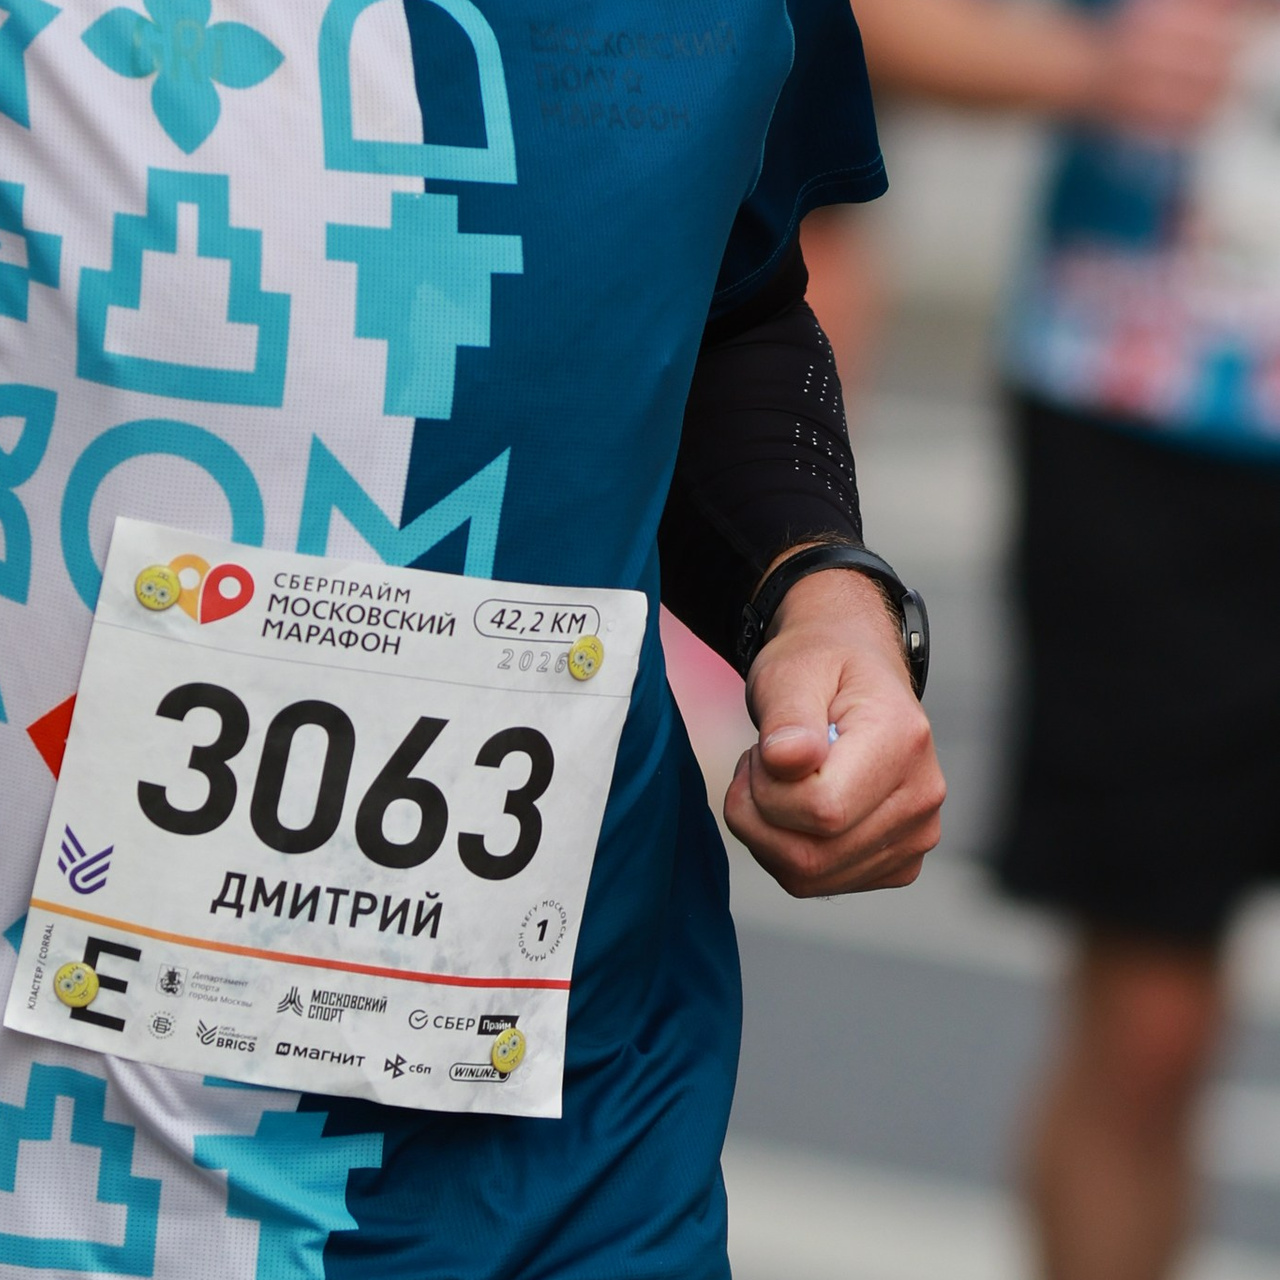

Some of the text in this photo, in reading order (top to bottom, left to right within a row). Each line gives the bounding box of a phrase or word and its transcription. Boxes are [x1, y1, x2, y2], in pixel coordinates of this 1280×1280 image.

[273, 572, 413, 604] СБЕРПРАЙМ
[267, 593, 457, 637] МОСКОВСКИЙ
[489, 608, 588, 636] 42,2 КМ
[262, 619, 402, 655] МАРАФОН
[137, 681, 556, 881] 3063
[209, 870, 444, 940] ДМИТРИЙ
[536, 918, 549, 942] 1
[27, 966, 45, 1010] КЛАСТЕР
[39, 923, 55, 960] CORRAL
[69, 935, 142, 1033] E
[190, 981, 220, 993] спорта
[192, 971, 249, 988] Департамент
[188, 990, 253, 1008] города Москвы
[310, 989, 389, 1014] МОСКОВСКИЙ
[307, 1004, 345, 1023] СПОРТ
[433, 1015, 512, 1032] СБЕР Прайм
[216, 1037, 257, 1053] BRICS
[408, 1063, 432, 1075] сбп
[453, 1066, 498, 1079] WINLINE
